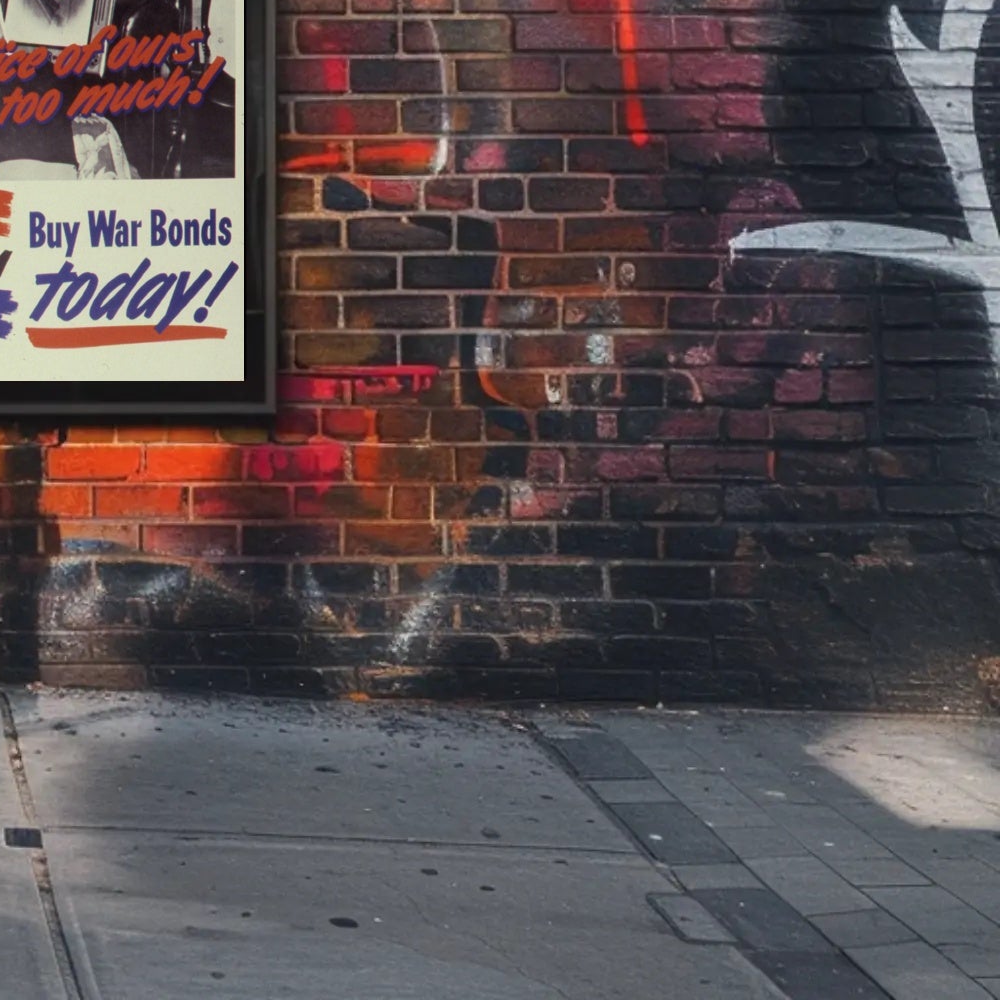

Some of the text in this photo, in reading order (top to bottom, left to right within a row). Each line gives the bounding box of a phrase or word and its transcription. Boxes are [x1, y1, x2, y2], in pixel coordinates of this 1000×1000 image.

[53, 24, 118, 79] of
[107, 29, 204, 72] ours
[66, 56, 225, 119] much!
[28, 209, 232, 257] Buy War Bonds
[29, 257, 240, 334] today!
